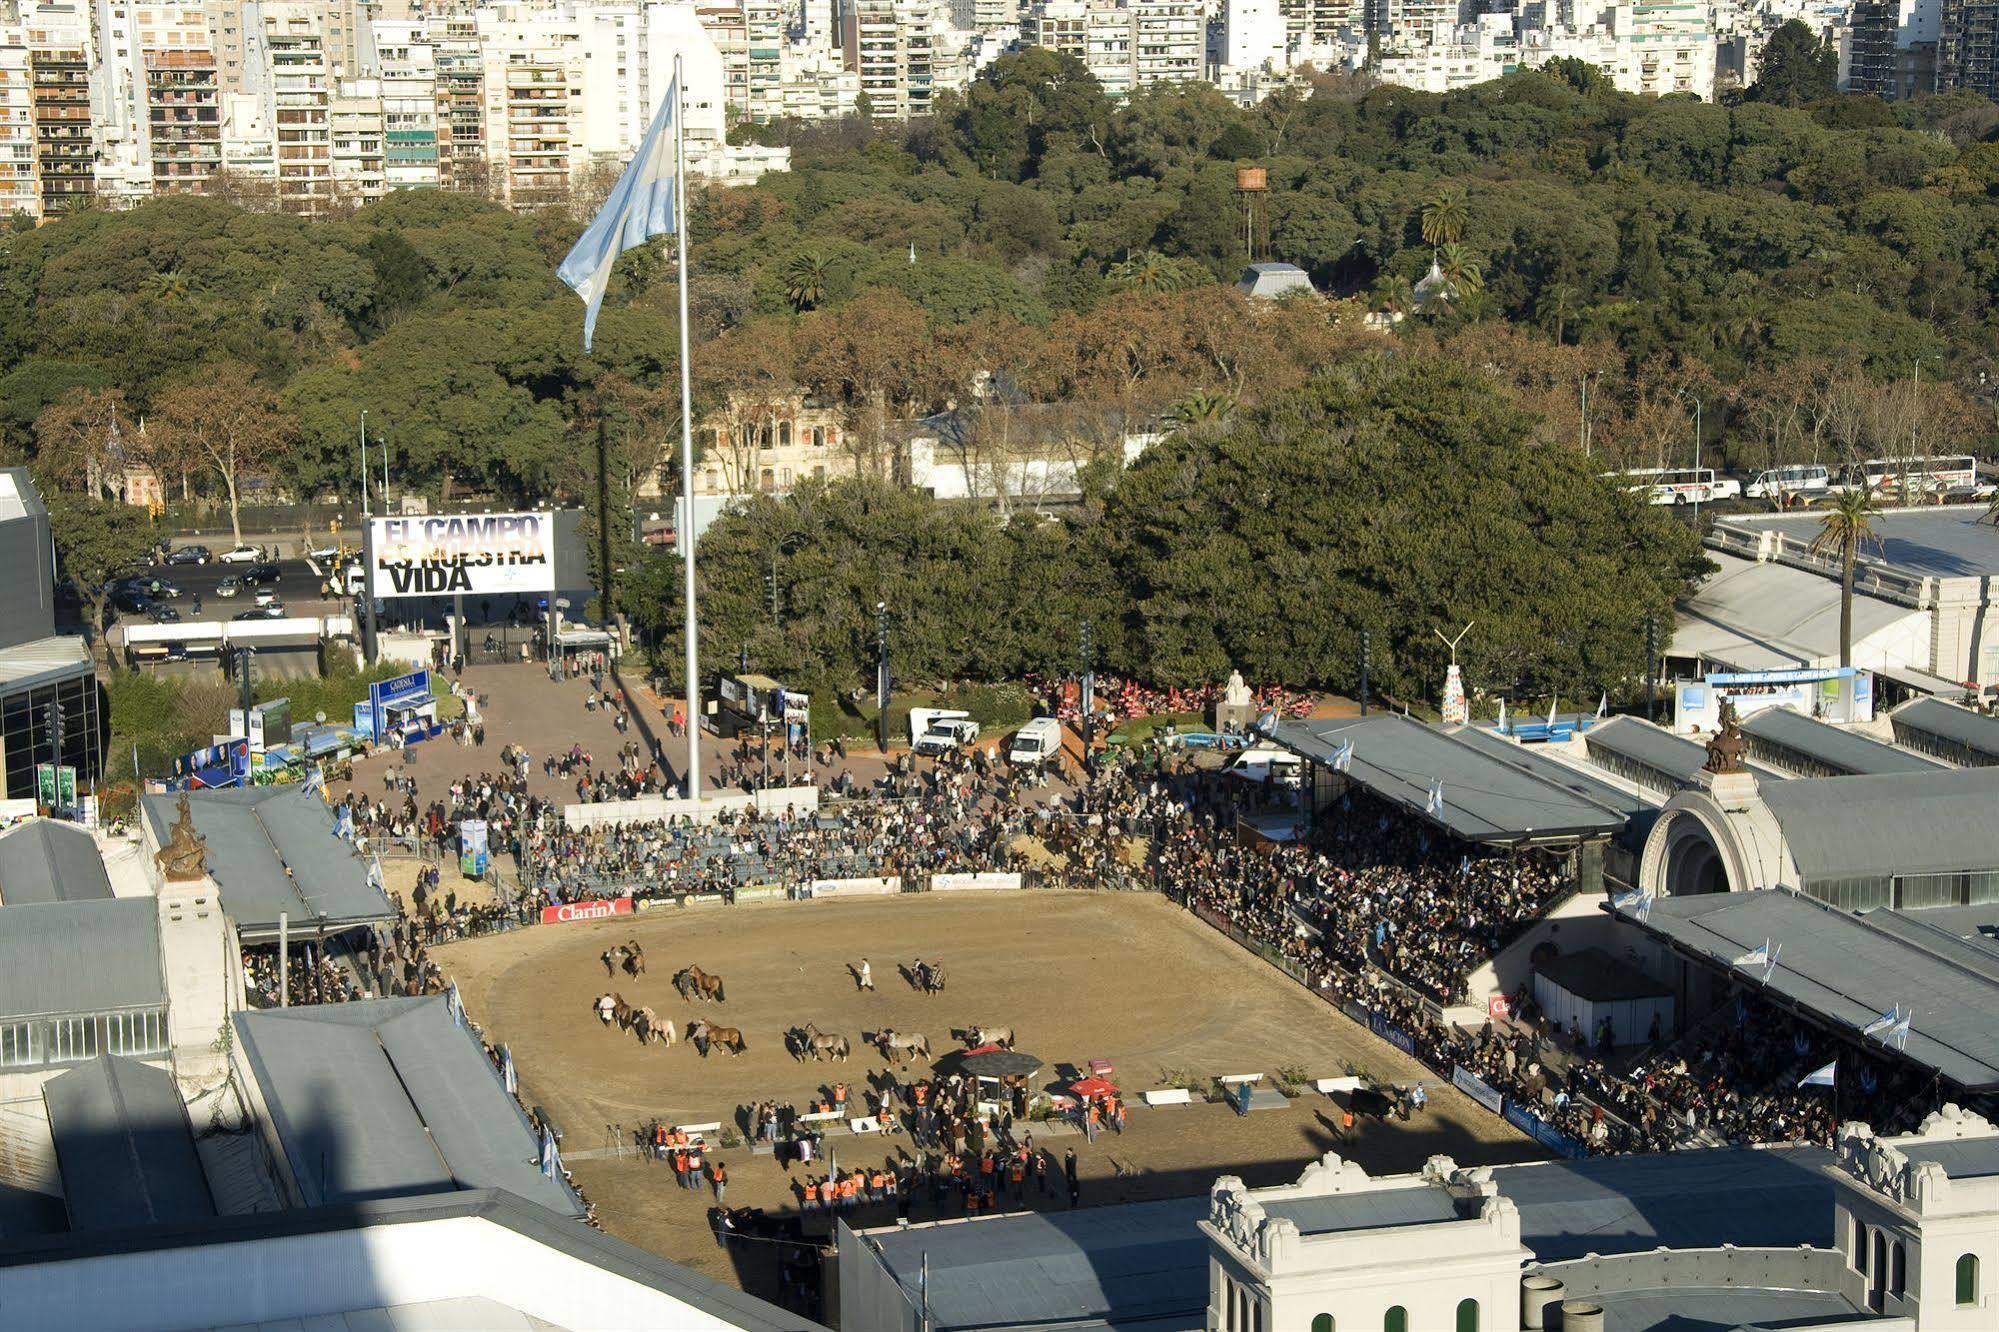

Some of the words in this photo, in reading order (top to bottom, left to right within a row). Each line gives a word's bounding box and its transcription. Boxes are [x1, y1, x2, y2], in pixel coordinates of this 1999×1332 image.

[385, 519, 409, 545] EL
[424, 516, 539, 544] CAMPO
[421, 543, 546, 568] NUESTRA
[389, 567, 473, 593] VIDA
